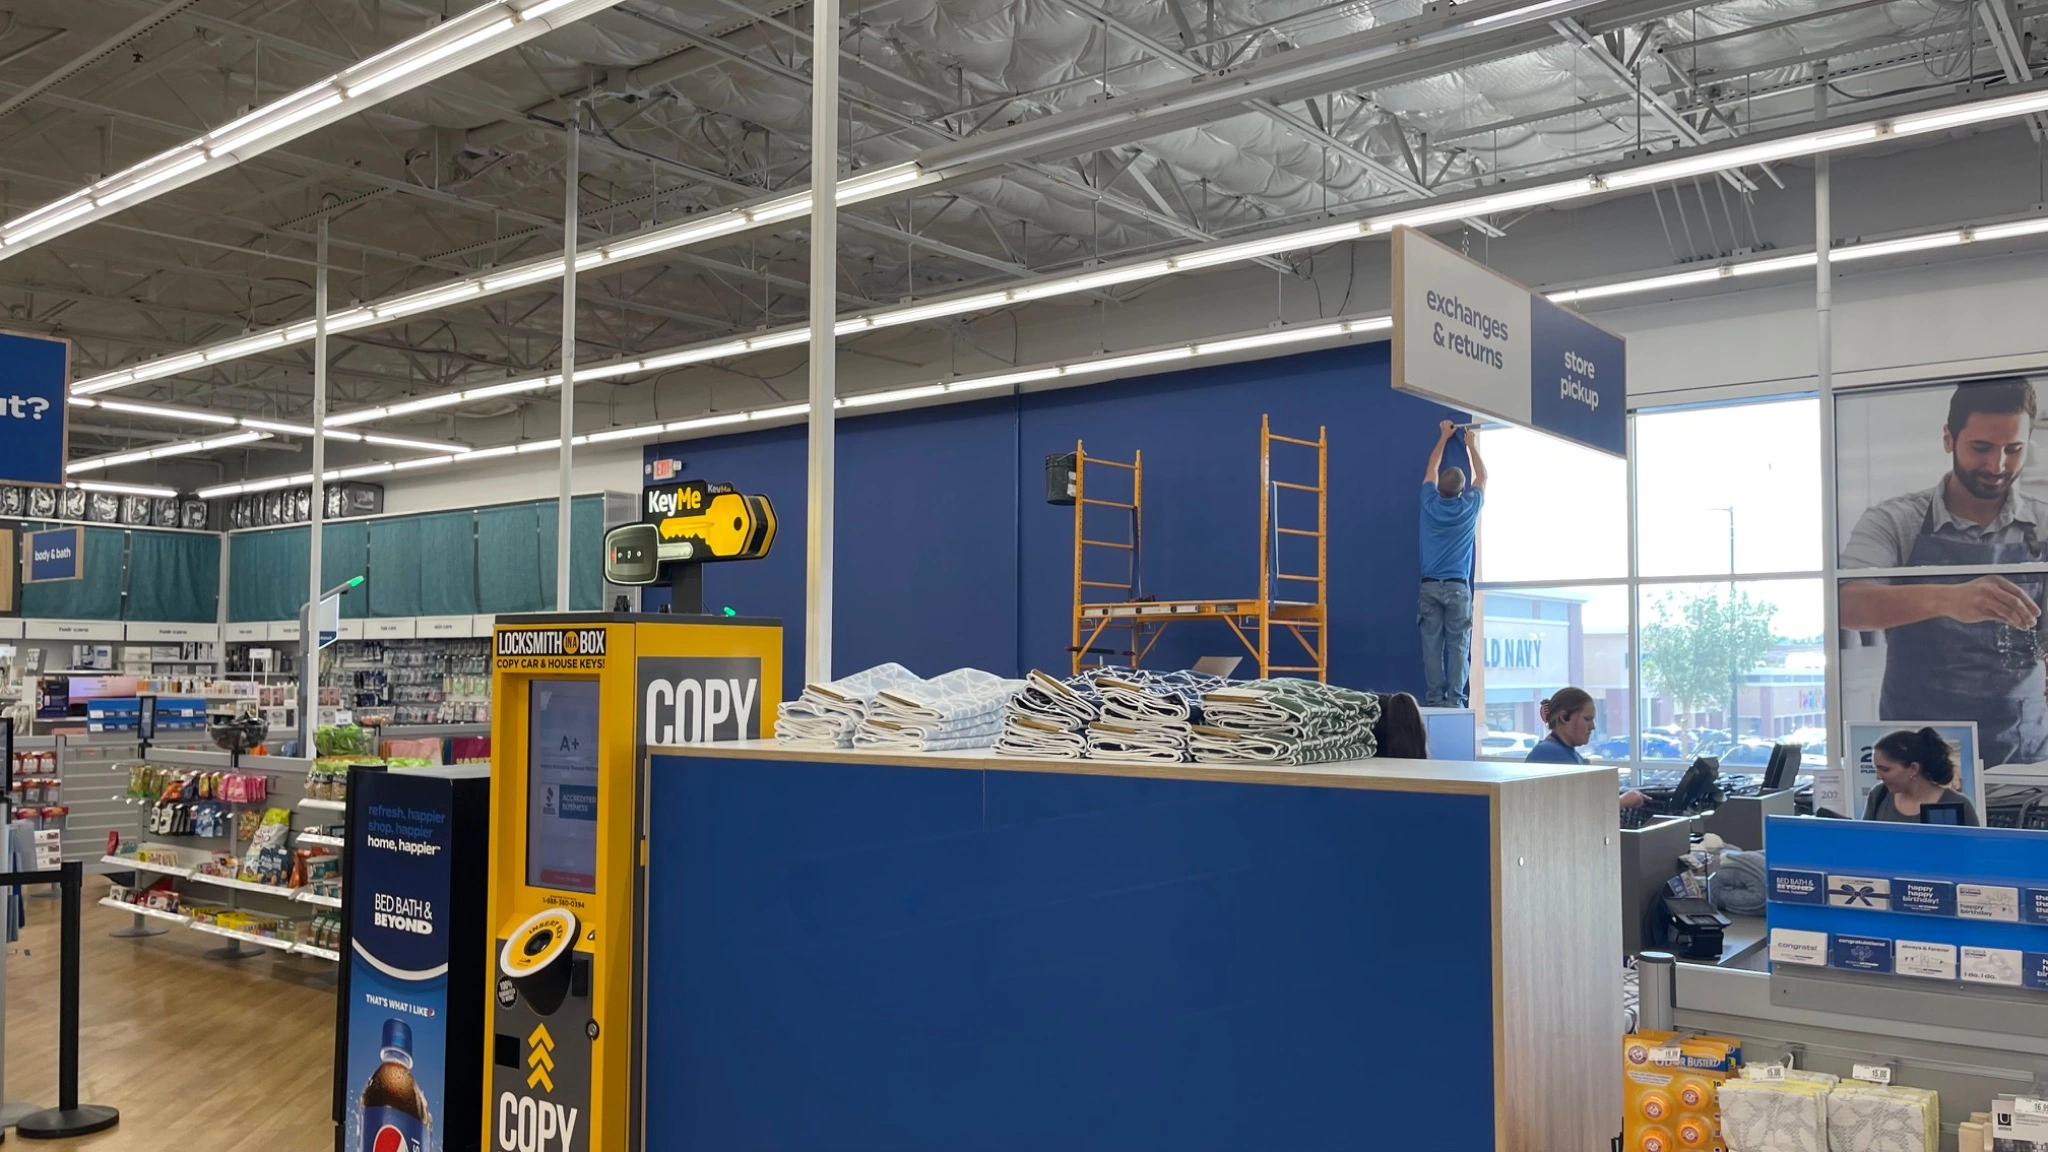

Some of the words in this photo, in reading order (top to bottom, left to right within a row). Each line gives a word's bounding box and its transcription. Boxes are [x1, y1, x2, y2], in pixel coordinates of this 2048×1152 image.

[1426, 290, 1508, 341] exchanges
[1433, 321, 1445, 347] &
[1448, 332, 1503, 370] returns
[1564, 351, 1595, 379] store
[1560, 374, 1599, 411] pickup
[648, 487, 702, 517] KeyMe
[34, 549, 50, 563] body
[56, 546, 72, 559] bath
[498, 631, 563, 655] LOCKSMITH
[565, 636, 573, 649] IN
[572, 636, 578, 648] A
[579, 630, 605, 654] BOX
[1484, 637, 1500, 668] LD
[1505, 638, 1541, 668] NAVY
[496, 658, 519, 669] COPY
[521, 659, 540, 669] CAR
[540, 659, 547, 669] &
[548, 659, 578, 669] HOUSE
[579, 658, 606, 669] KEYS!
[646, 678, 758, 745] COPY
[560, 735, 580, 751] A+
[368, 804, 406, 821] refresh,
[407, 807, 446, 825] happier
[368, 820, 394, 836] shop,
[395, 822, 434, 839] happier
[367, 834, 397, 853] home,
[1907, 884, 1934, 893] happy
[1907, 890, 1934, 899] happy
[375, 892, 395, 913] BED
[395, 896, 423, 919] BATH
[423, 901, 433, 921] &
[374, 911, 433, 935] BEYOND
[1777, 941, 1818, 951] congrats!
[366, 993, 388, 1008] THAT'S
[388, 999, 408, 1012] WHAT
[413, 1005, 429, 1017] LIKE
[499, 1091, 578, 1152] COPY
